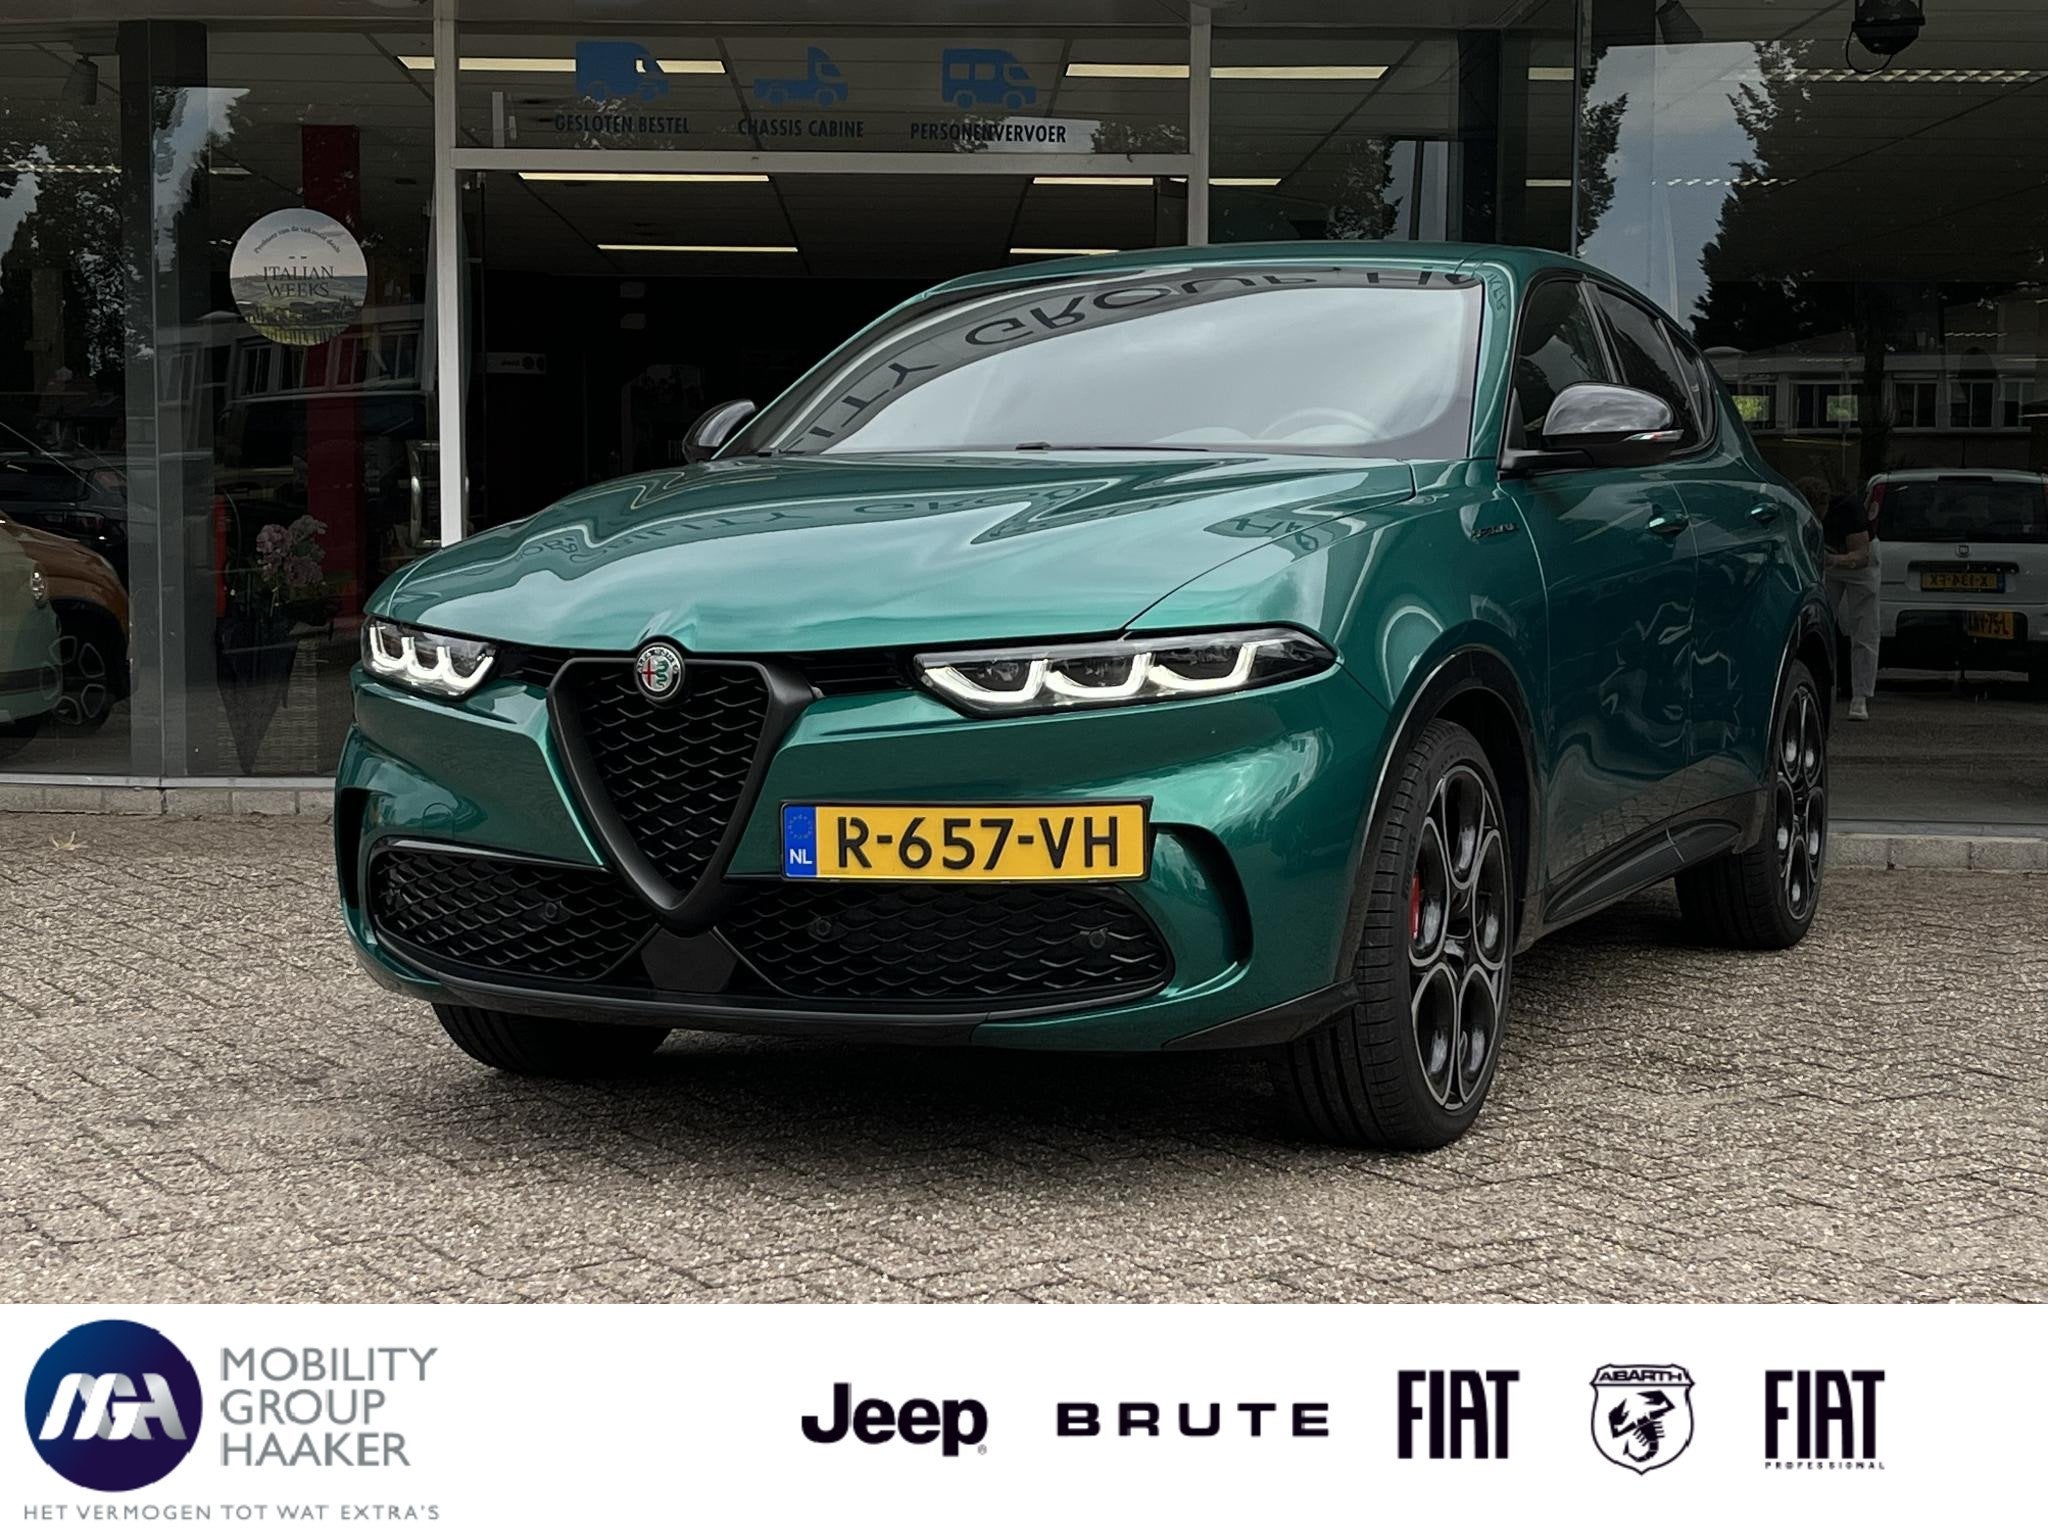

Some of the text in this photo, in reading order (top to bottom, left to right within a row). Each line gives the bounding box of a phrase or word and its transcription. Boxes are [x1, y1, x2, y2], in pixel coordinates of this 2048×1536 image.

[555, 114, 690, 134] GESLOTEN BESTEL
[737, 118, 864, 138] CHASSIS CABINE
[910, 122, 1067, 143] PERSONENVERVOER
[263, 265, 335, 281] ITALIAN
[266, 282, 330, 298] WEEKS
[836, 815, 1119, 871] R-657-VH
[789, 847, 813, 866] NL
